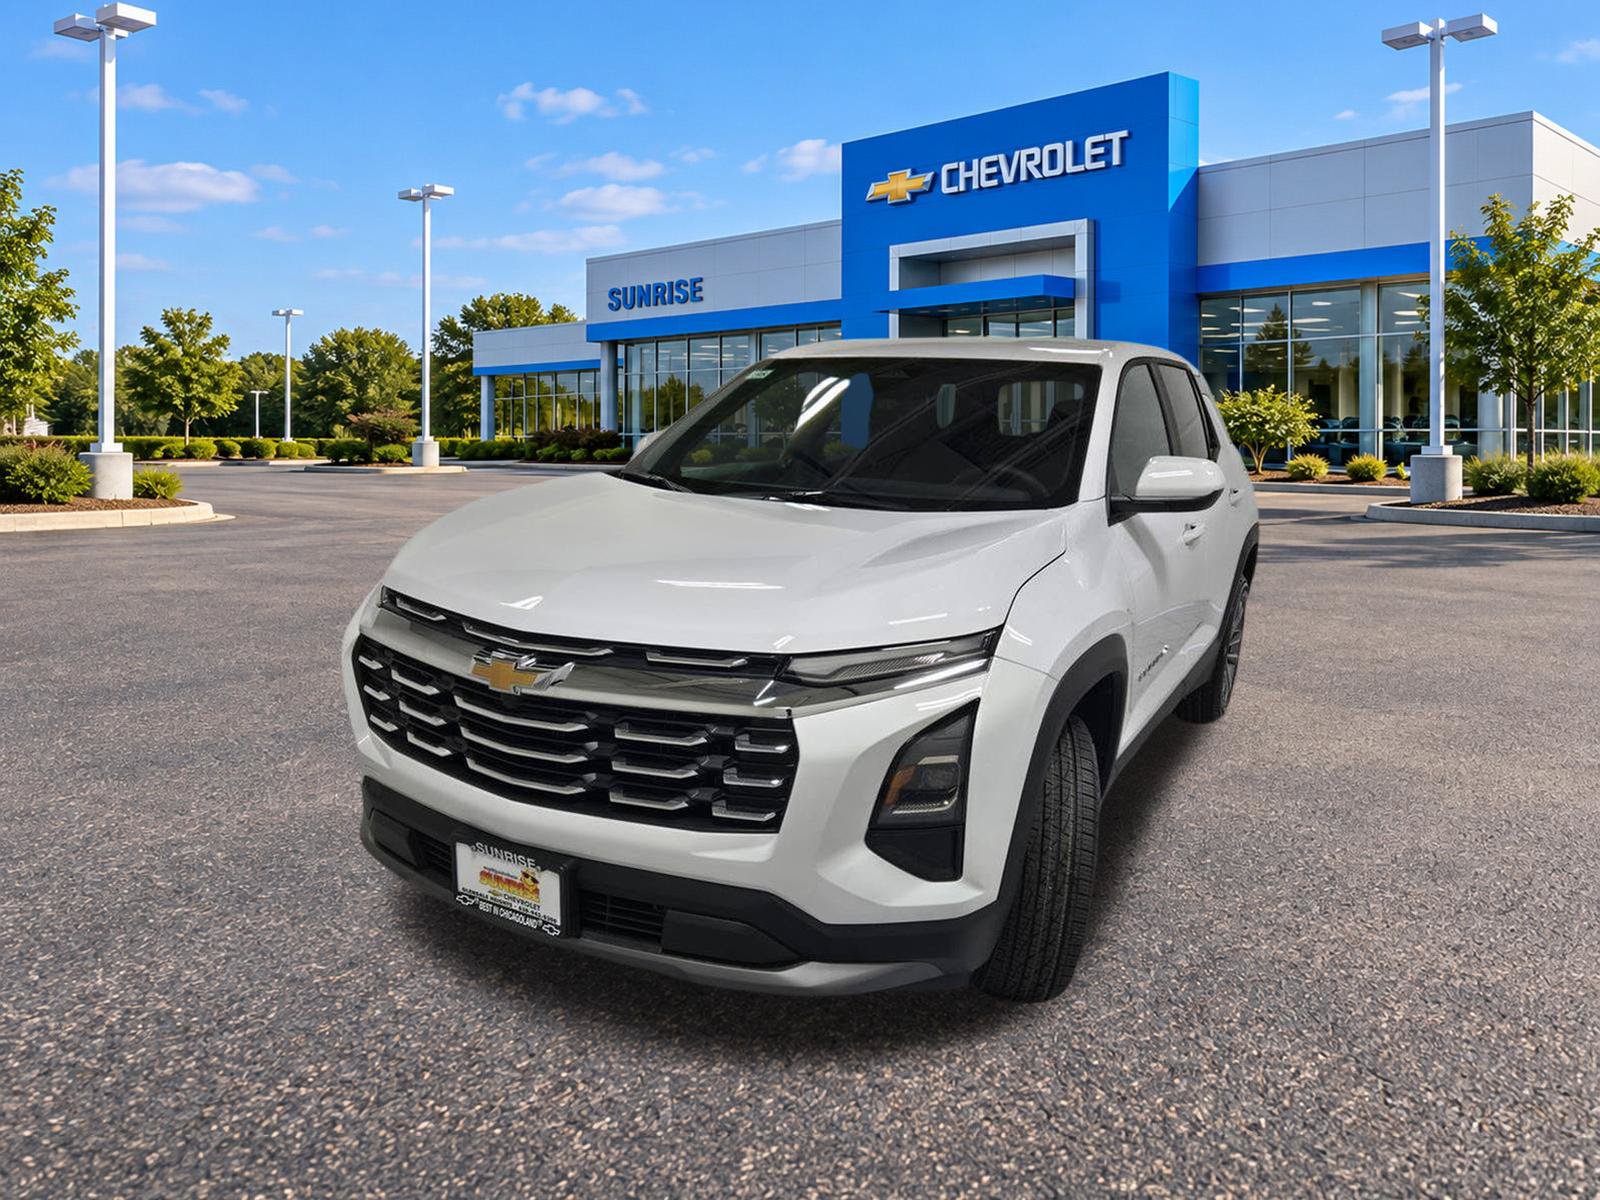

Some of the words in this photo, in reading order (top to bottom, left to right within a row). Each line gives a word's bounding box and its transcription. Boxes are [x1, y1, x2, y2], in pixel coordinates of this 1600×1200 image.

[941, 130, 1129, 194] CHEVROLET
[608, 277, 704, 312] SUNRISE
[475, 842, 536, 868] SUNRISE
